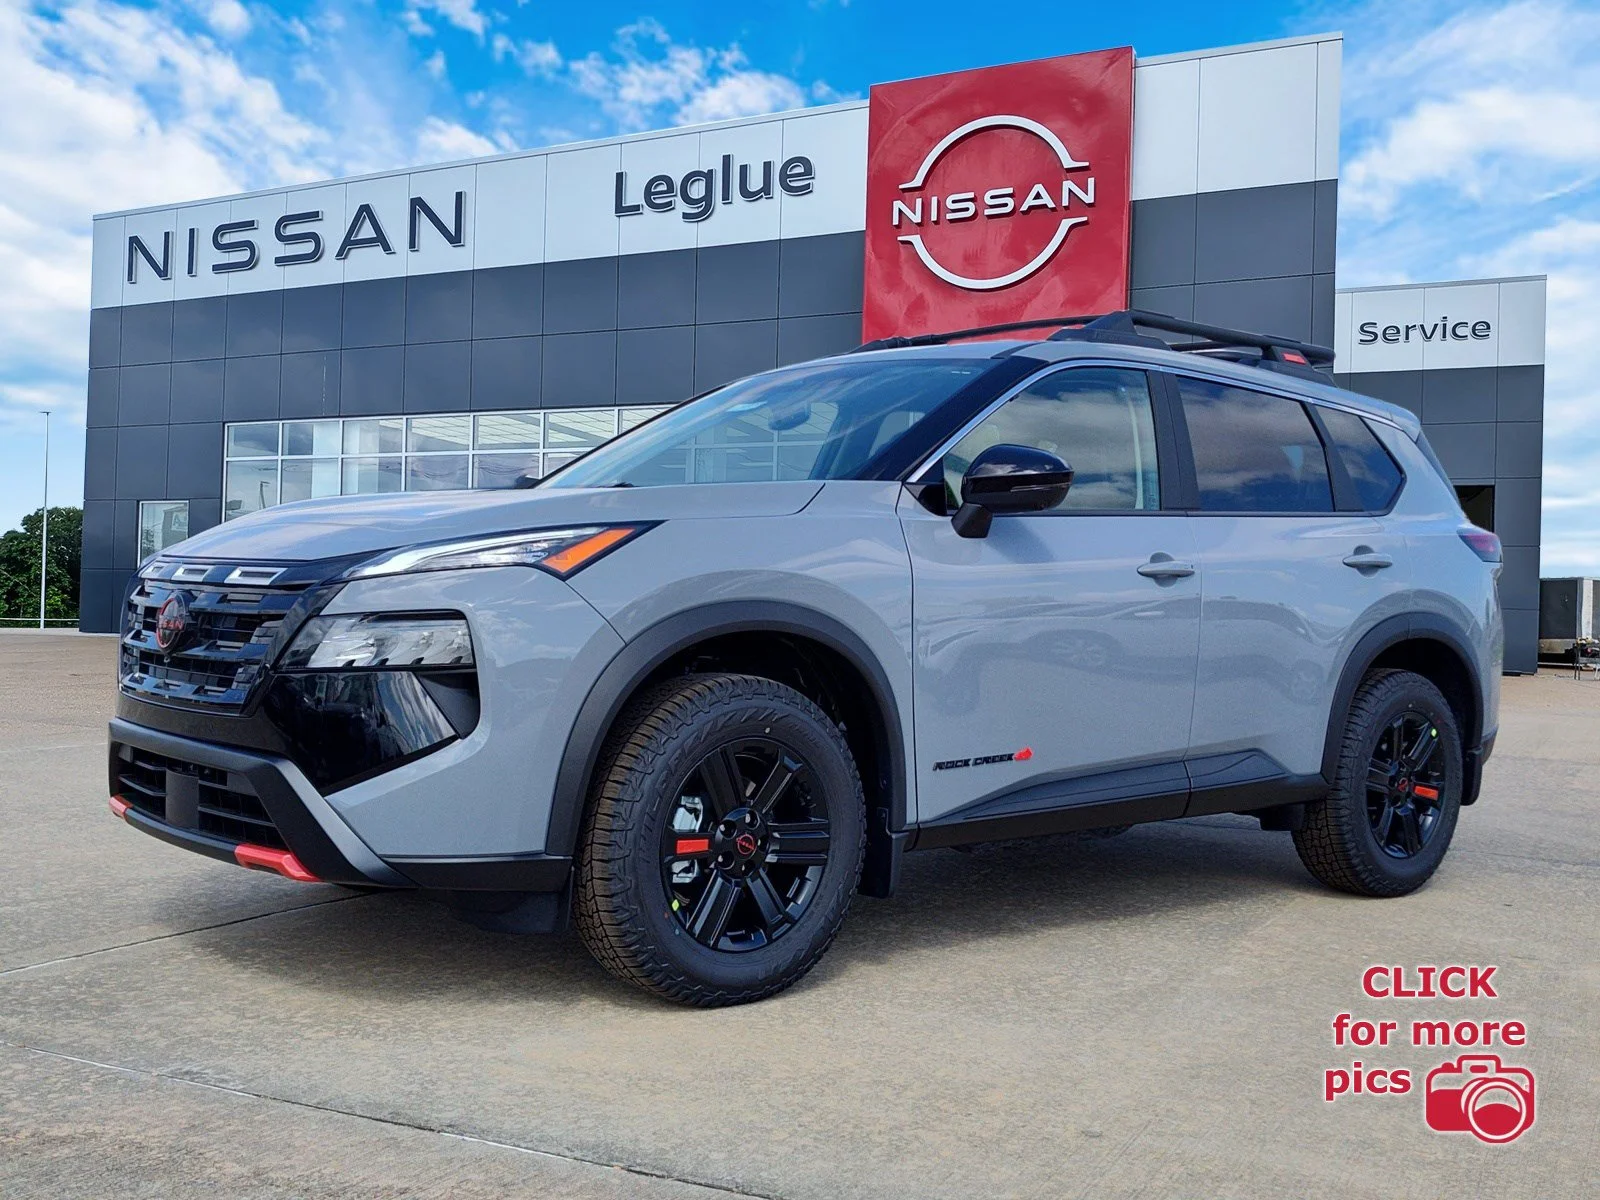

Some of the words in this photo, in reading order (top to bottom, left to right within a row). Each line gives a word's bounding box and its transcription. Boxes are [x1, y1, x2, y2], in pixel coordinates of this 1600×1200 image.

[614, 153, 816, 223] Leglue
[892, 177, 1096, 227] NISSAN
[127, 190, 466, 284] NISSAN
[1358, 316, 1492, 345] Service
[932, 758, 972, 771] ROCK
